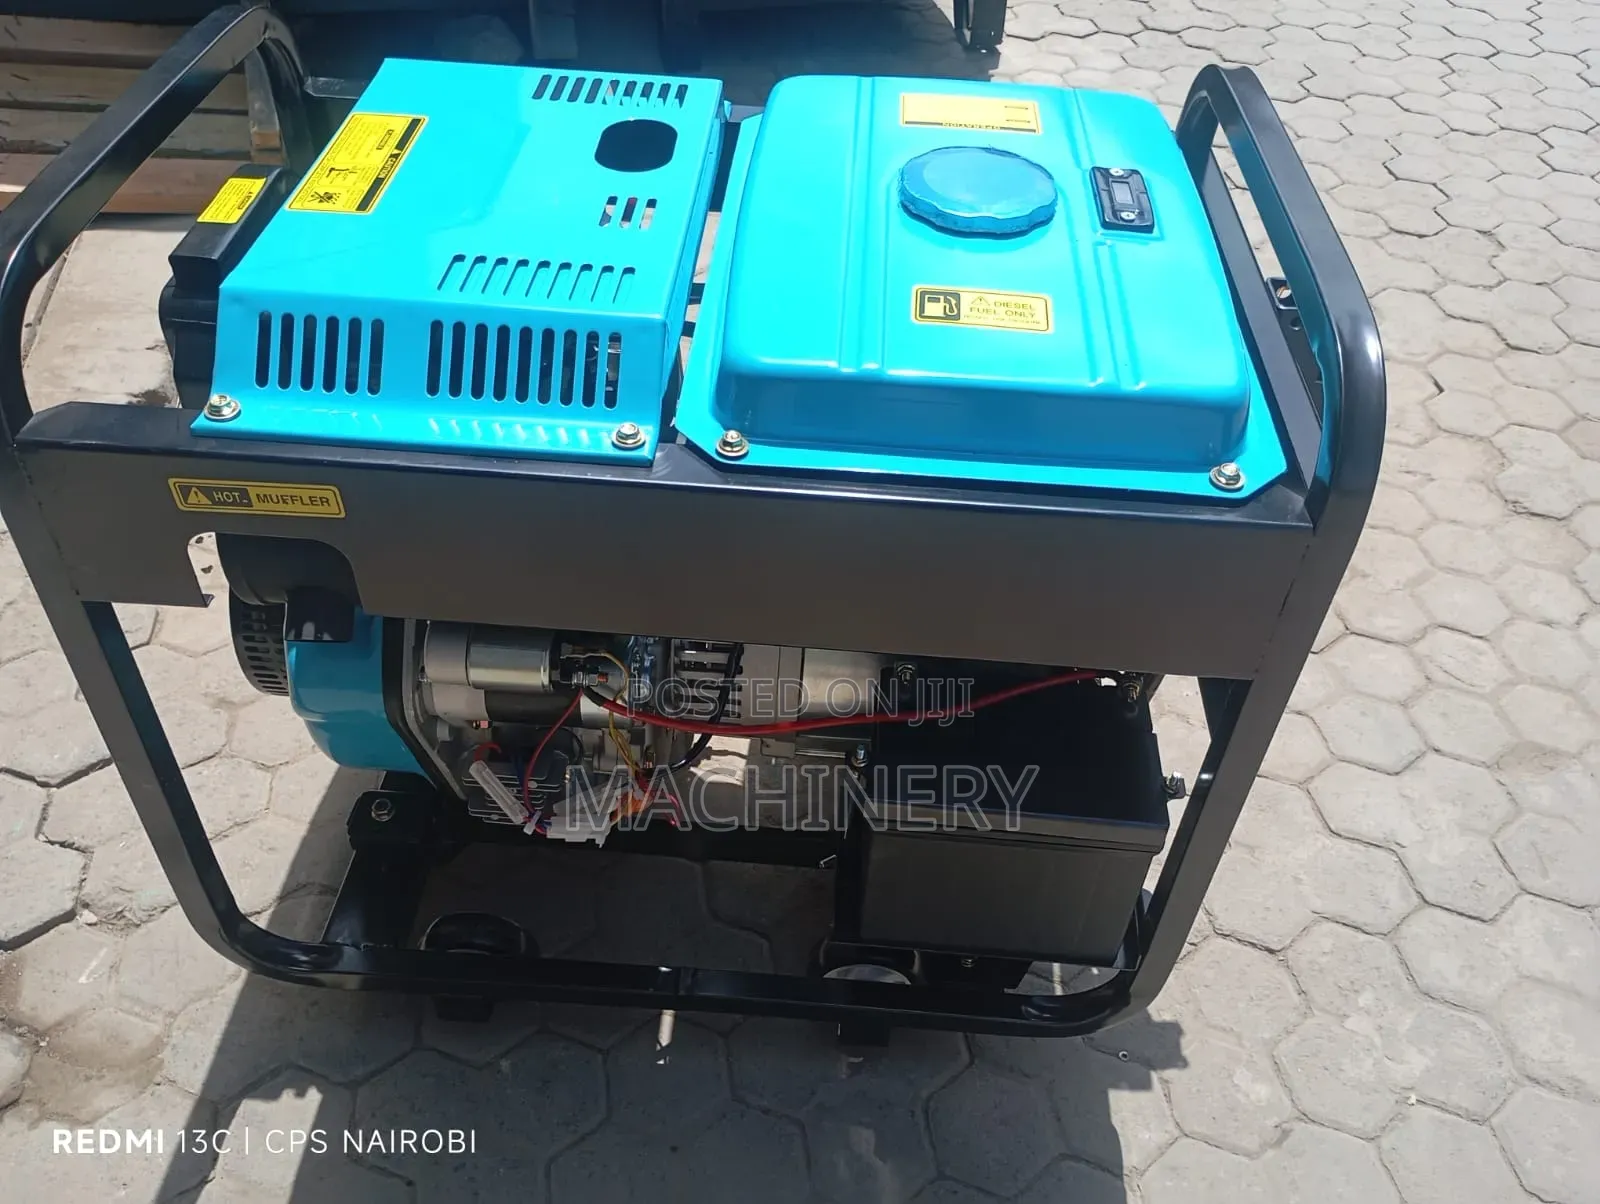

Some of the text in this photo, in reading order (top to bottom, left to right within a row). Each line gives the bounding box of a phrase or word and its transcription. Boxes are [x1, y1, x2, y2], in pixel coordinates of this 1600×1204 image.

[969, 306, 1036, 318] FUEL ONLY
[993, 301, 1036, 311] DIESEL
[255, 493, 331, 507] MUFFLER
